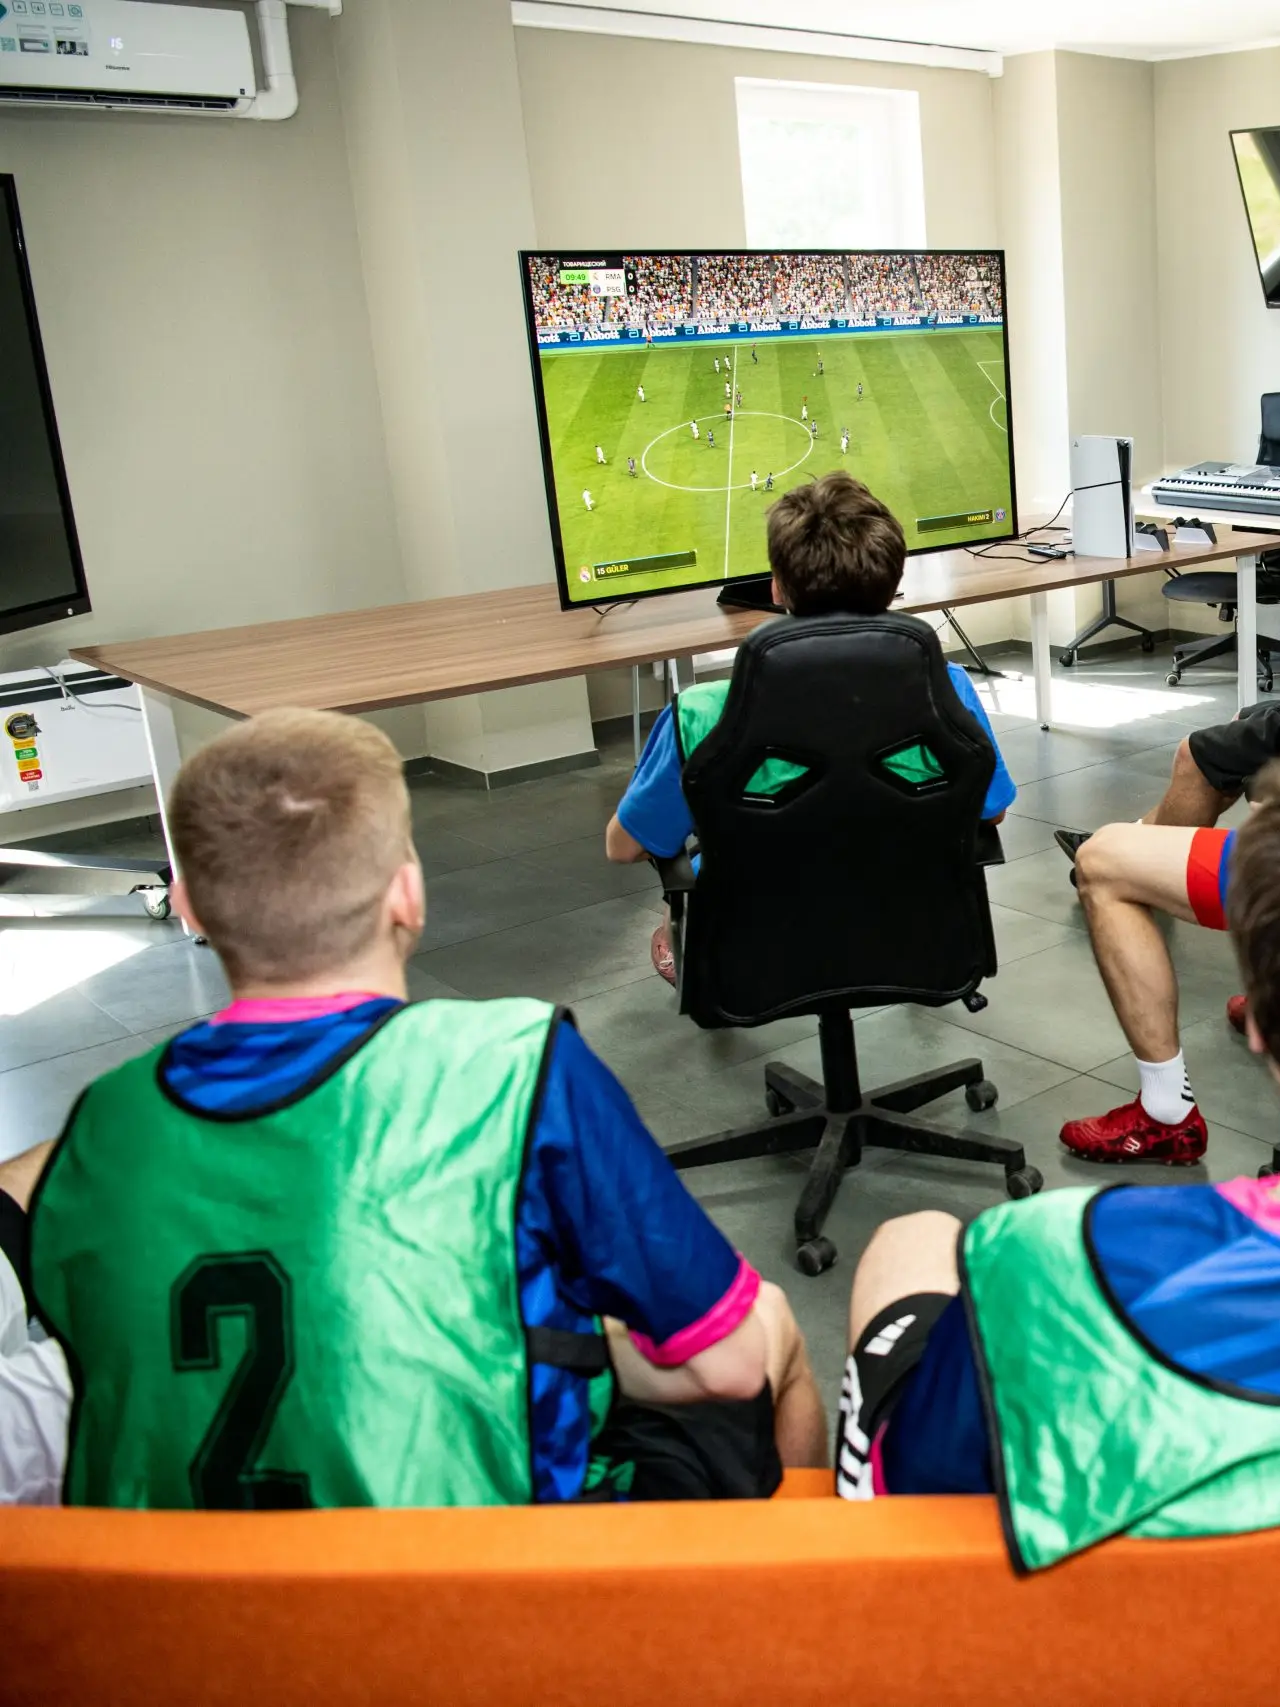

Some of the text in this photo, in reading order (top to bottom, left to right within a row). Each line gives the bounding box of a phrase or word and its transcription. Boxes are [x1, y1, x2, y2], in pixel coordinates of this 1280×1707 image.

[538, 333, 560, 343] bott
[583, 330, 620, 340] Abbott
[697, 324, 730, 334] Abbott
[750, 322, 781, 332] Abbott
[801, 319, 830, 328] Abbott
[848, 318, 876, 327] Abbott
[894, 317, 921, 325] Abbott
[937, 315, 963, 324] Abbott
[606, 565, 628, 573] GÜLER
[169, 1251, 312, 1510] 2
